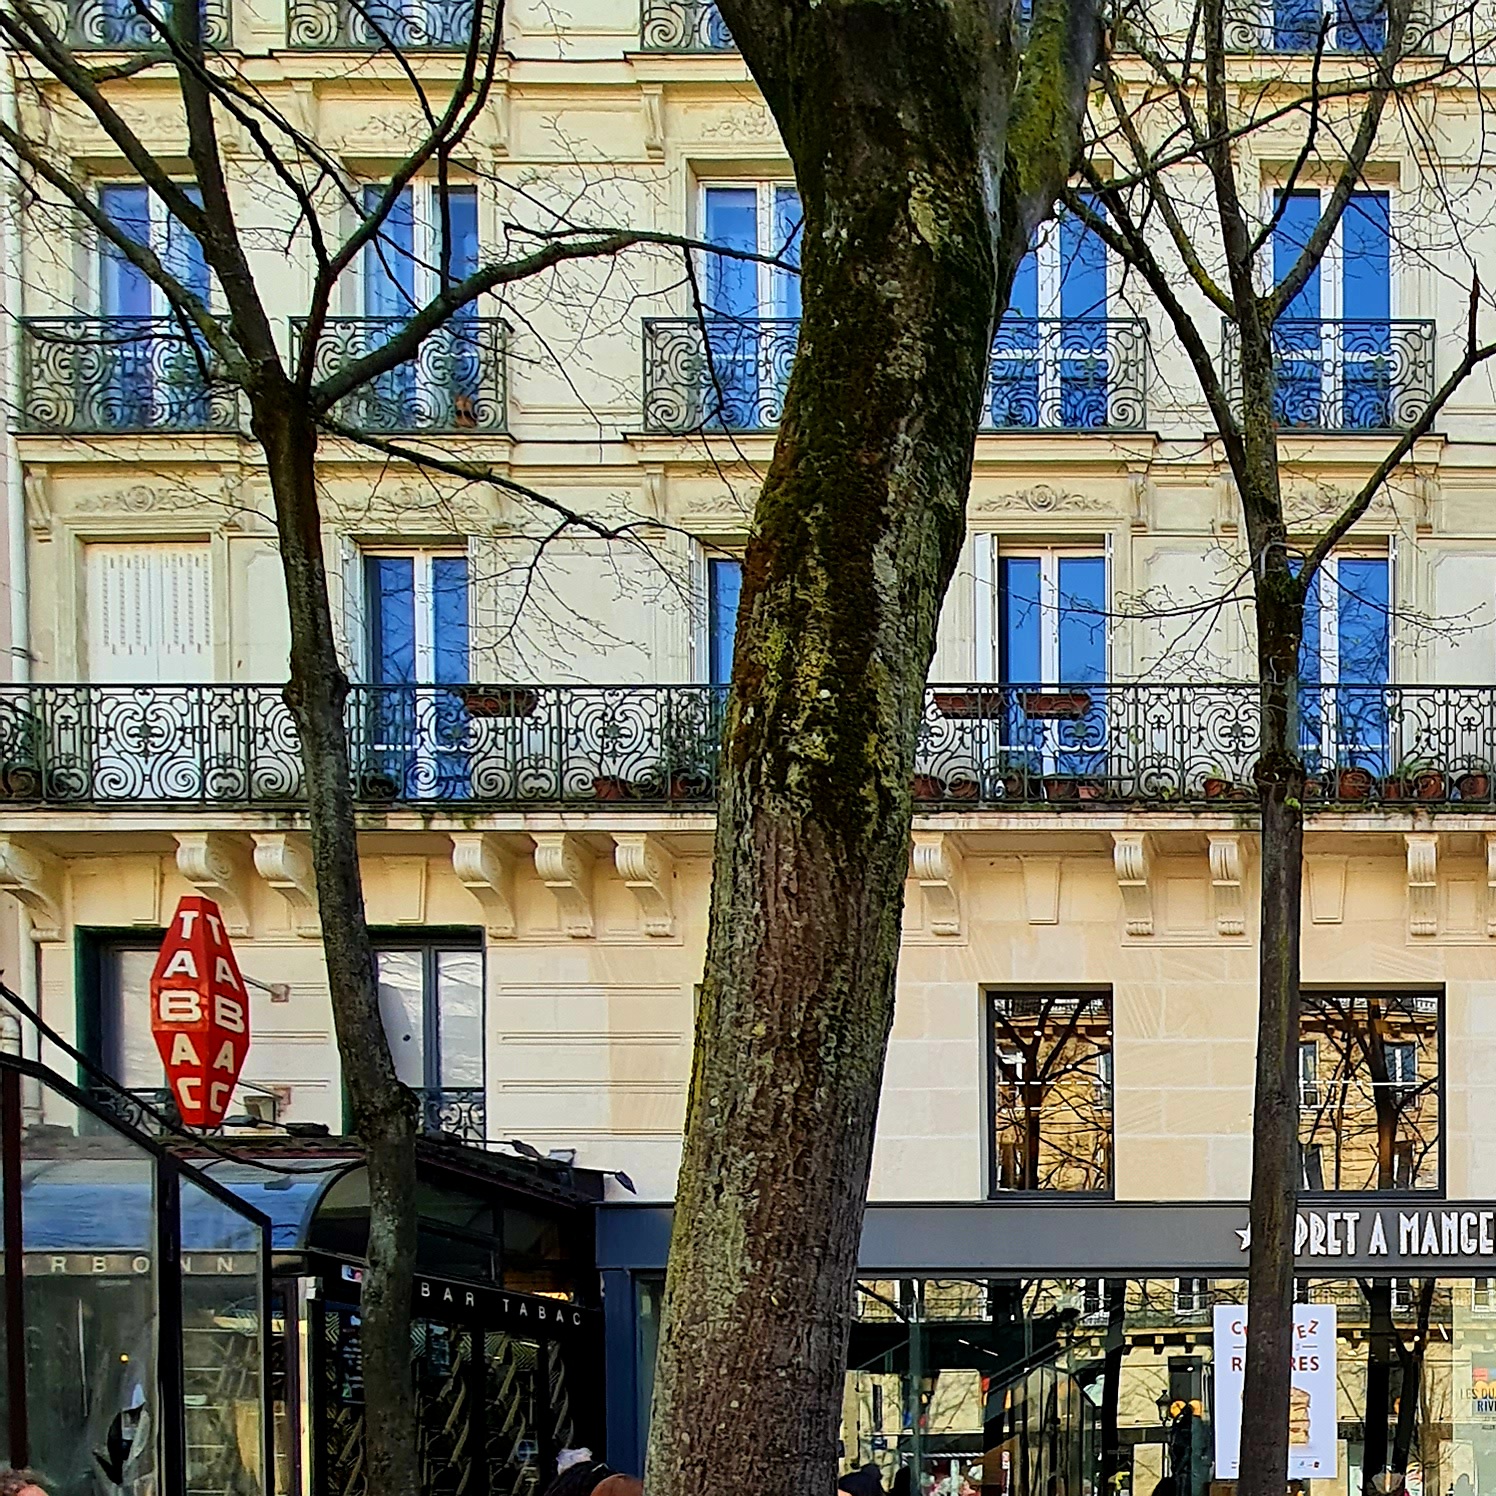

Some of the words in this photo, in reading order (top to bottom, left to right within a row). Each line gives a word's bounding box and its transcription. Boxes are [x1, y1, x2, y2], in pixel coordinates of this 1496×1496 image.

[159, 910, 203, 1110] TABAC
[205, 912, 245, 1114] TABAC
[1292, 1211, 1360, 1256] PRET
[1367, 1211, 1389, 1256] A
[420, 1282, 476, 1308] BAR
[502, 1298, 582, 1327] TABAC
